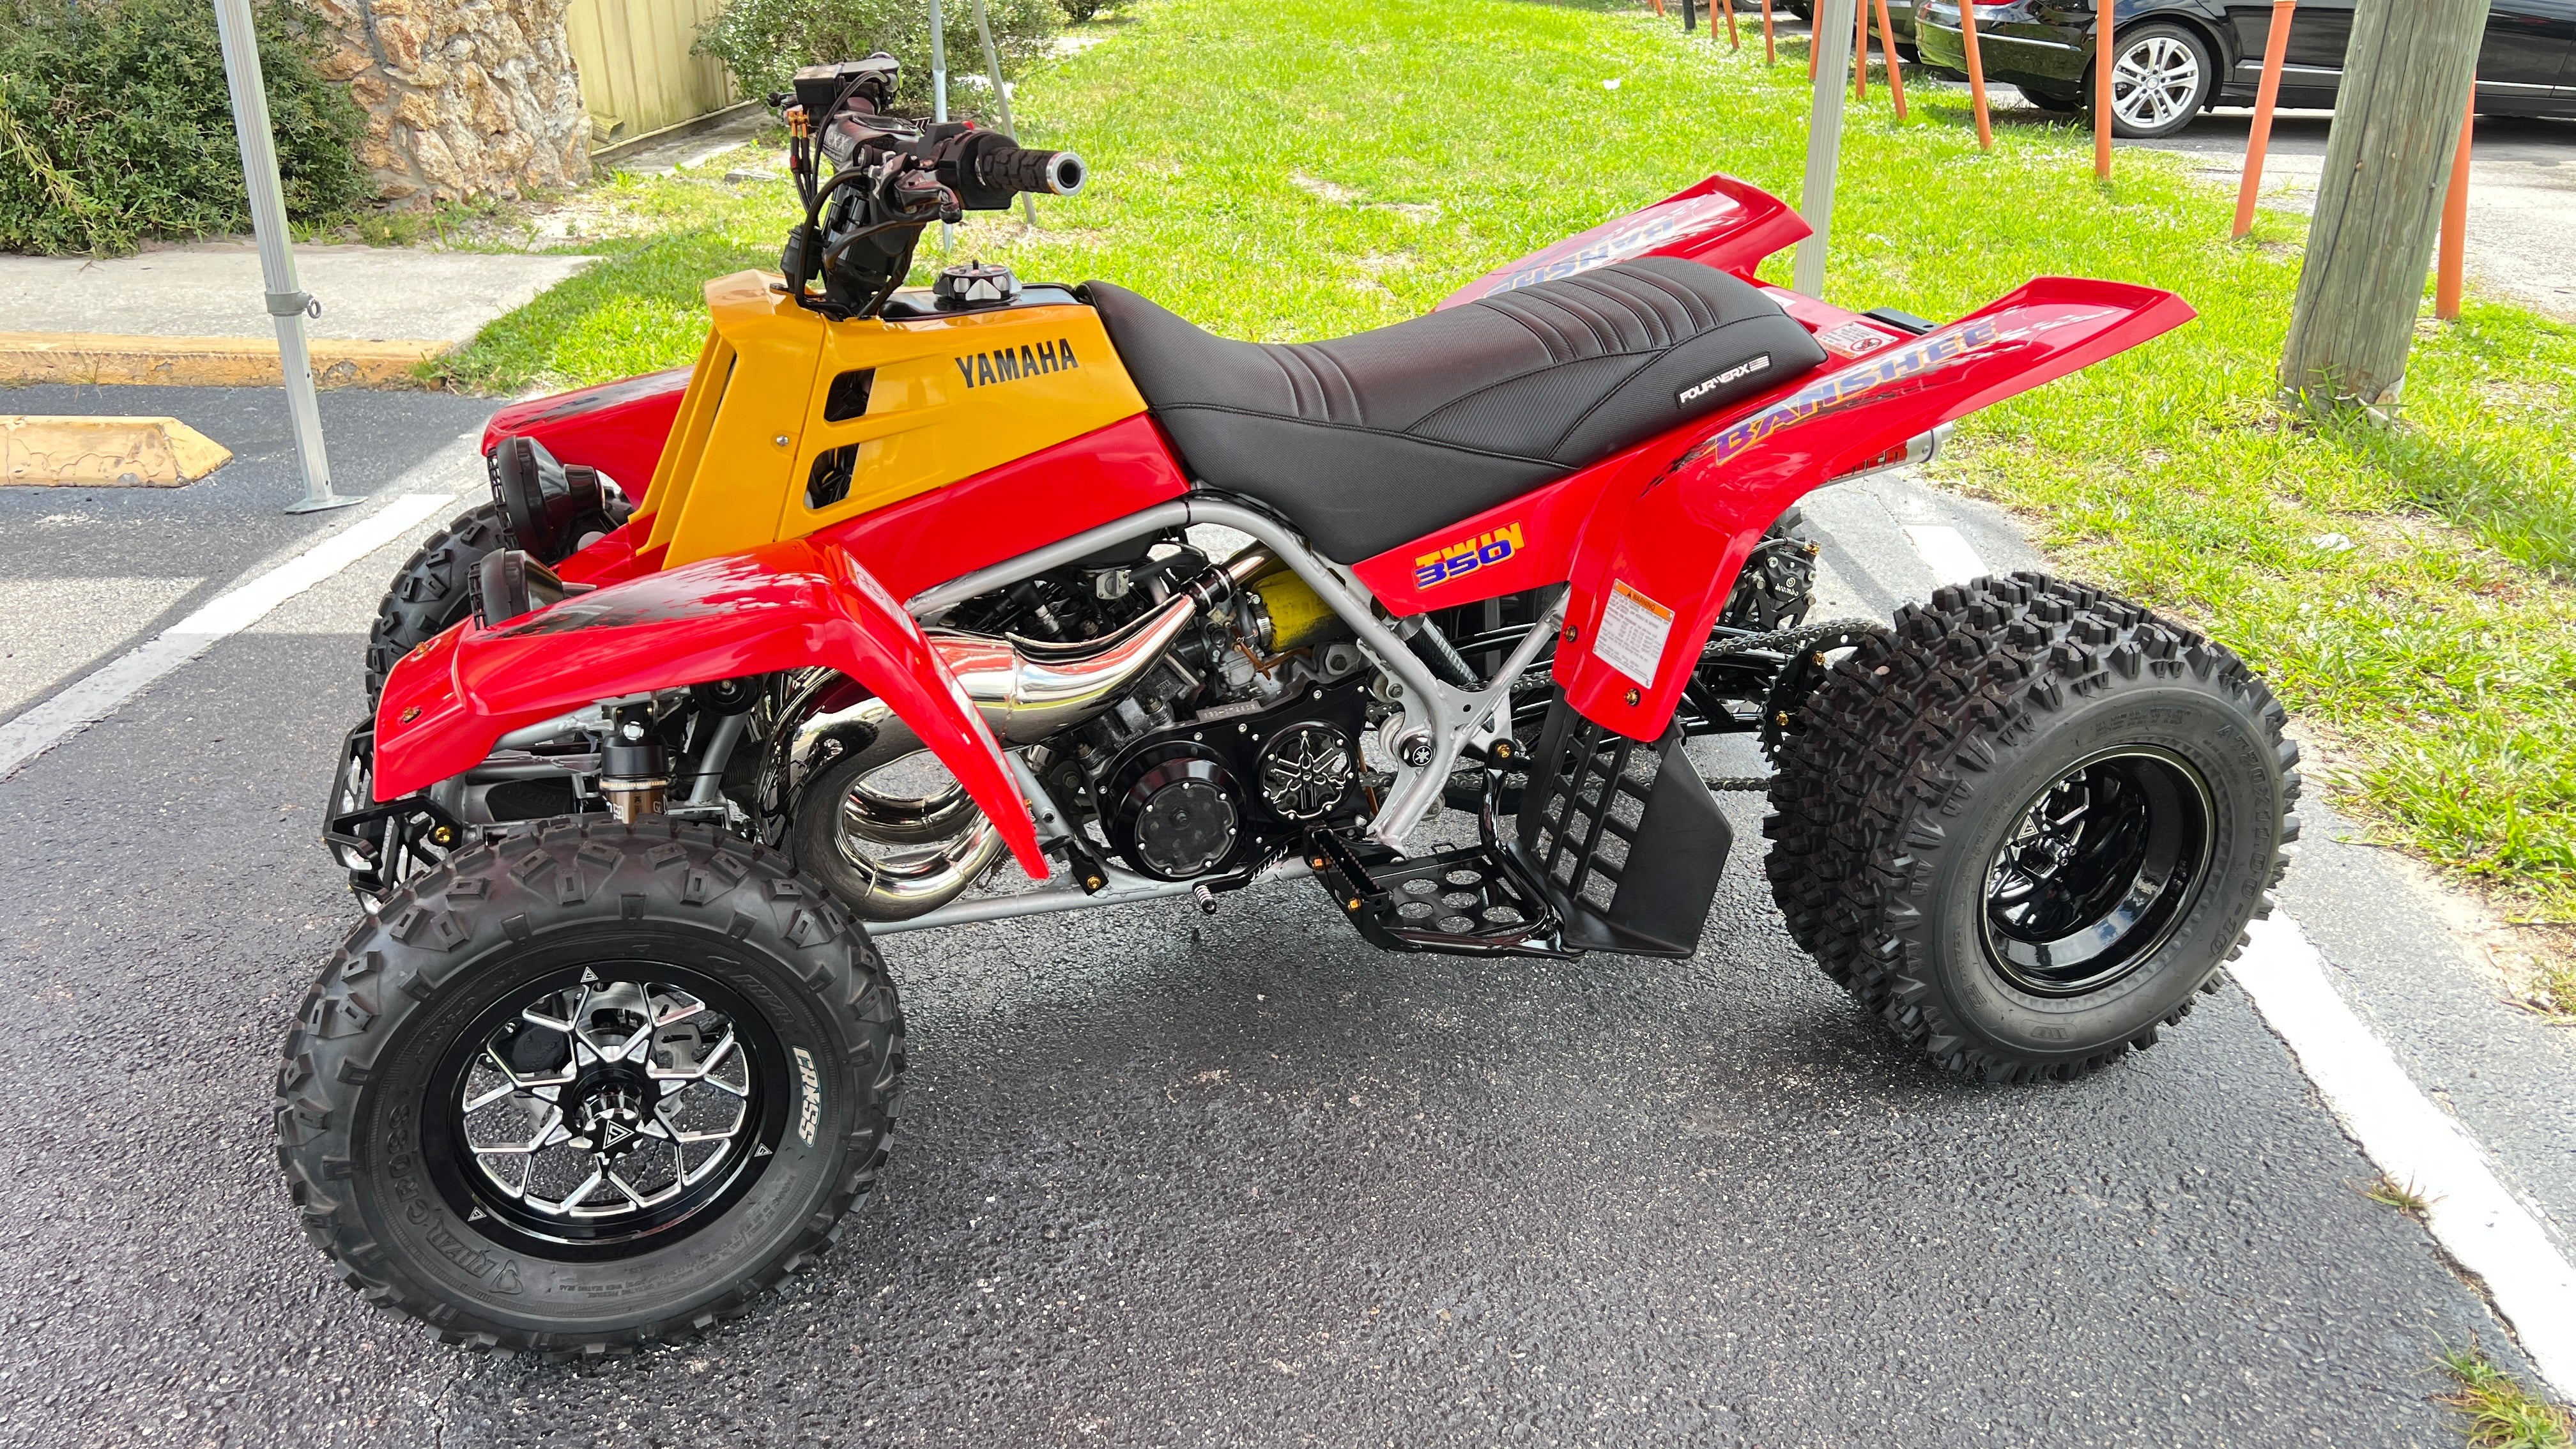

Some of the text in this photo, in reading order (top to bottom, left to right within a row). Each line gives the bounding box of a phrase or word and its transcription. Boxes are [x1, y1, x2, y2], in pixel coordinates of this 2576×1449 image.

[954, 337, 1079, 388] YAMAHA
[1679, 363, 1751, 404] FOURWERX
[1702, 320, 2000, 466] BANSHEE
[1414, 539, 1516, 590] 350
[1415, 521, 1525, 567] TWIN
[1632, 592, 1657, 611] WARNING
[387, 1104, 432, 1228] CROSS
